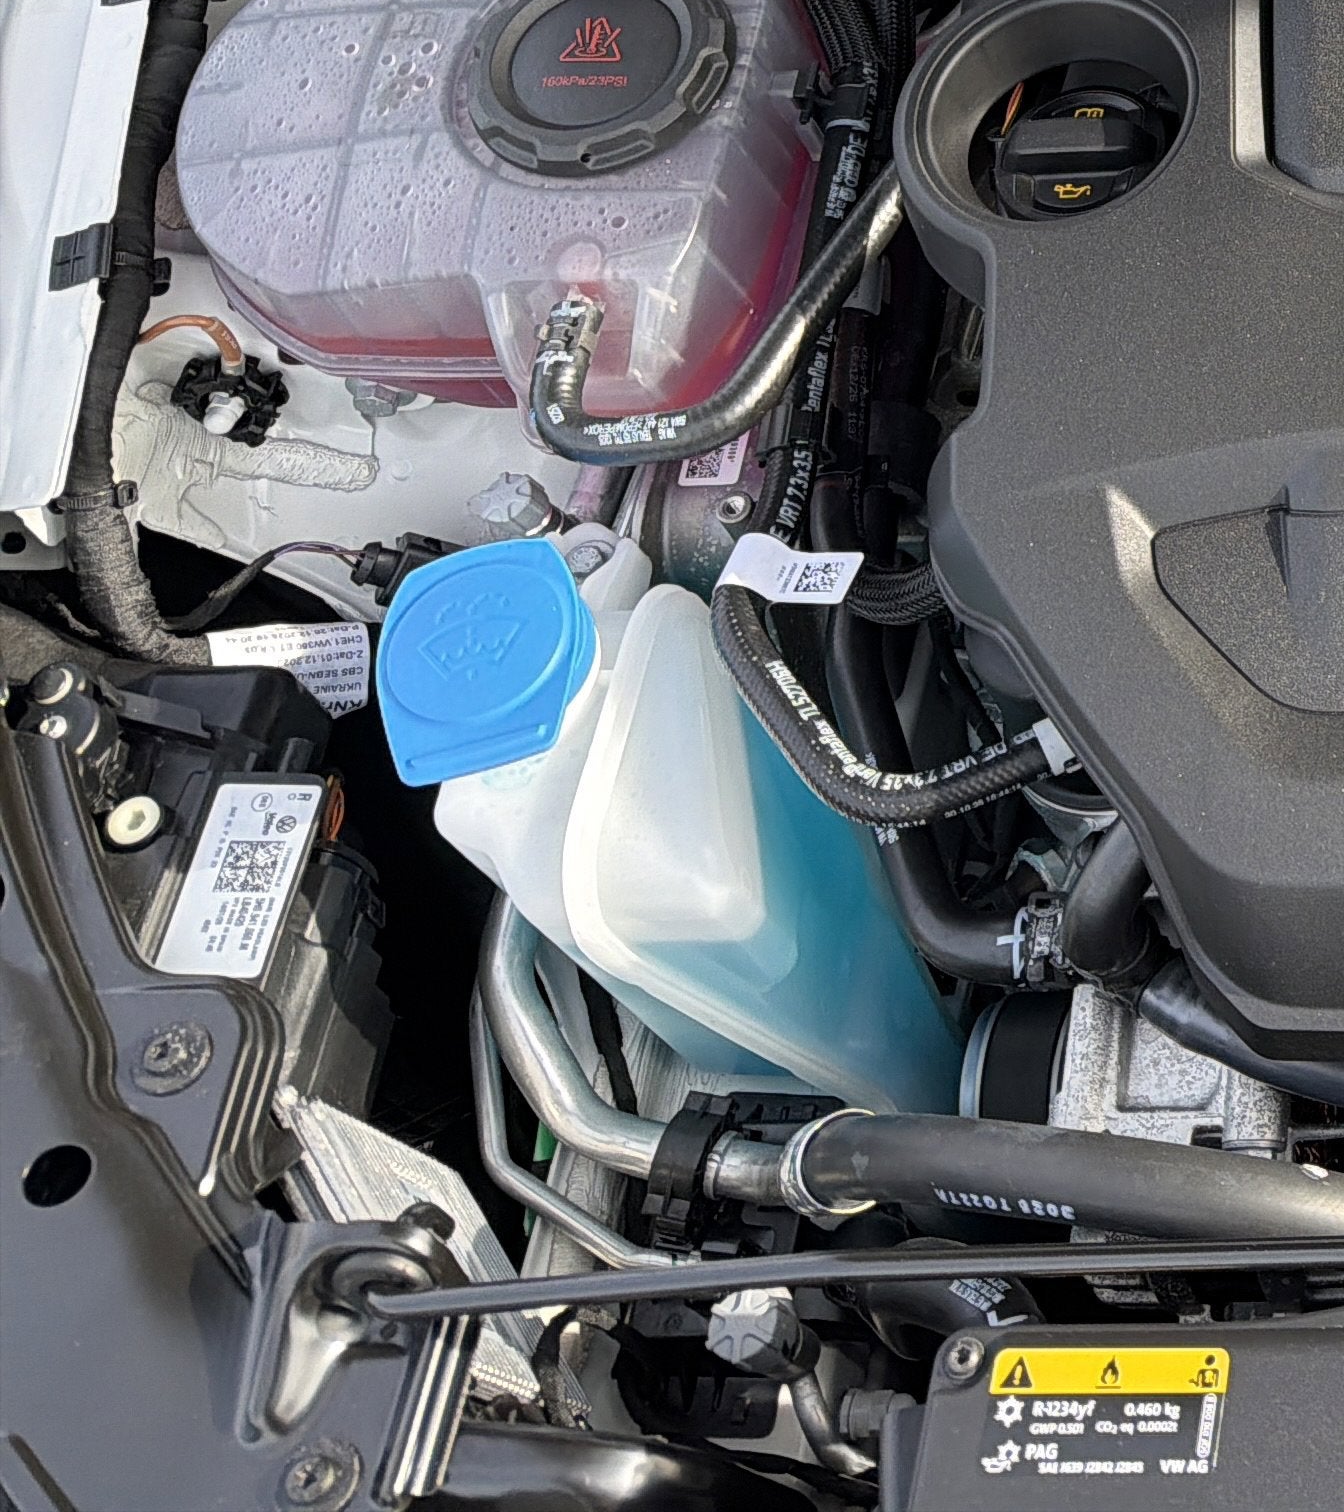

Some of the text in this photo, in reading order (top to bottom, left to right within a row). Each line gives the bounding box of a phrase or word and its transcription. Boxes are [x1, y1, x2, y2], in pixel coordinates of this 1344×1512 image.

[776, 497, 804, 529] VRT
[341, 666, 363, 677] CBS
[313, 682, 362, 695] UKRAINE
[814, 719, 857, 777] Pentaflex
[942, 755, 978, 780] VRT
[1032, 1399, 1181, 1421] R-1234yf 0.460 kg
[1029, 1423, 1057, 1435] GWP
[1120, 1423, 1134, 1436] eq
[1025, 1443, 1059, 1460] PAG
[1159, 1459, 1186, 1474] VW
[1187, 1459, 1209, 1474] AG
